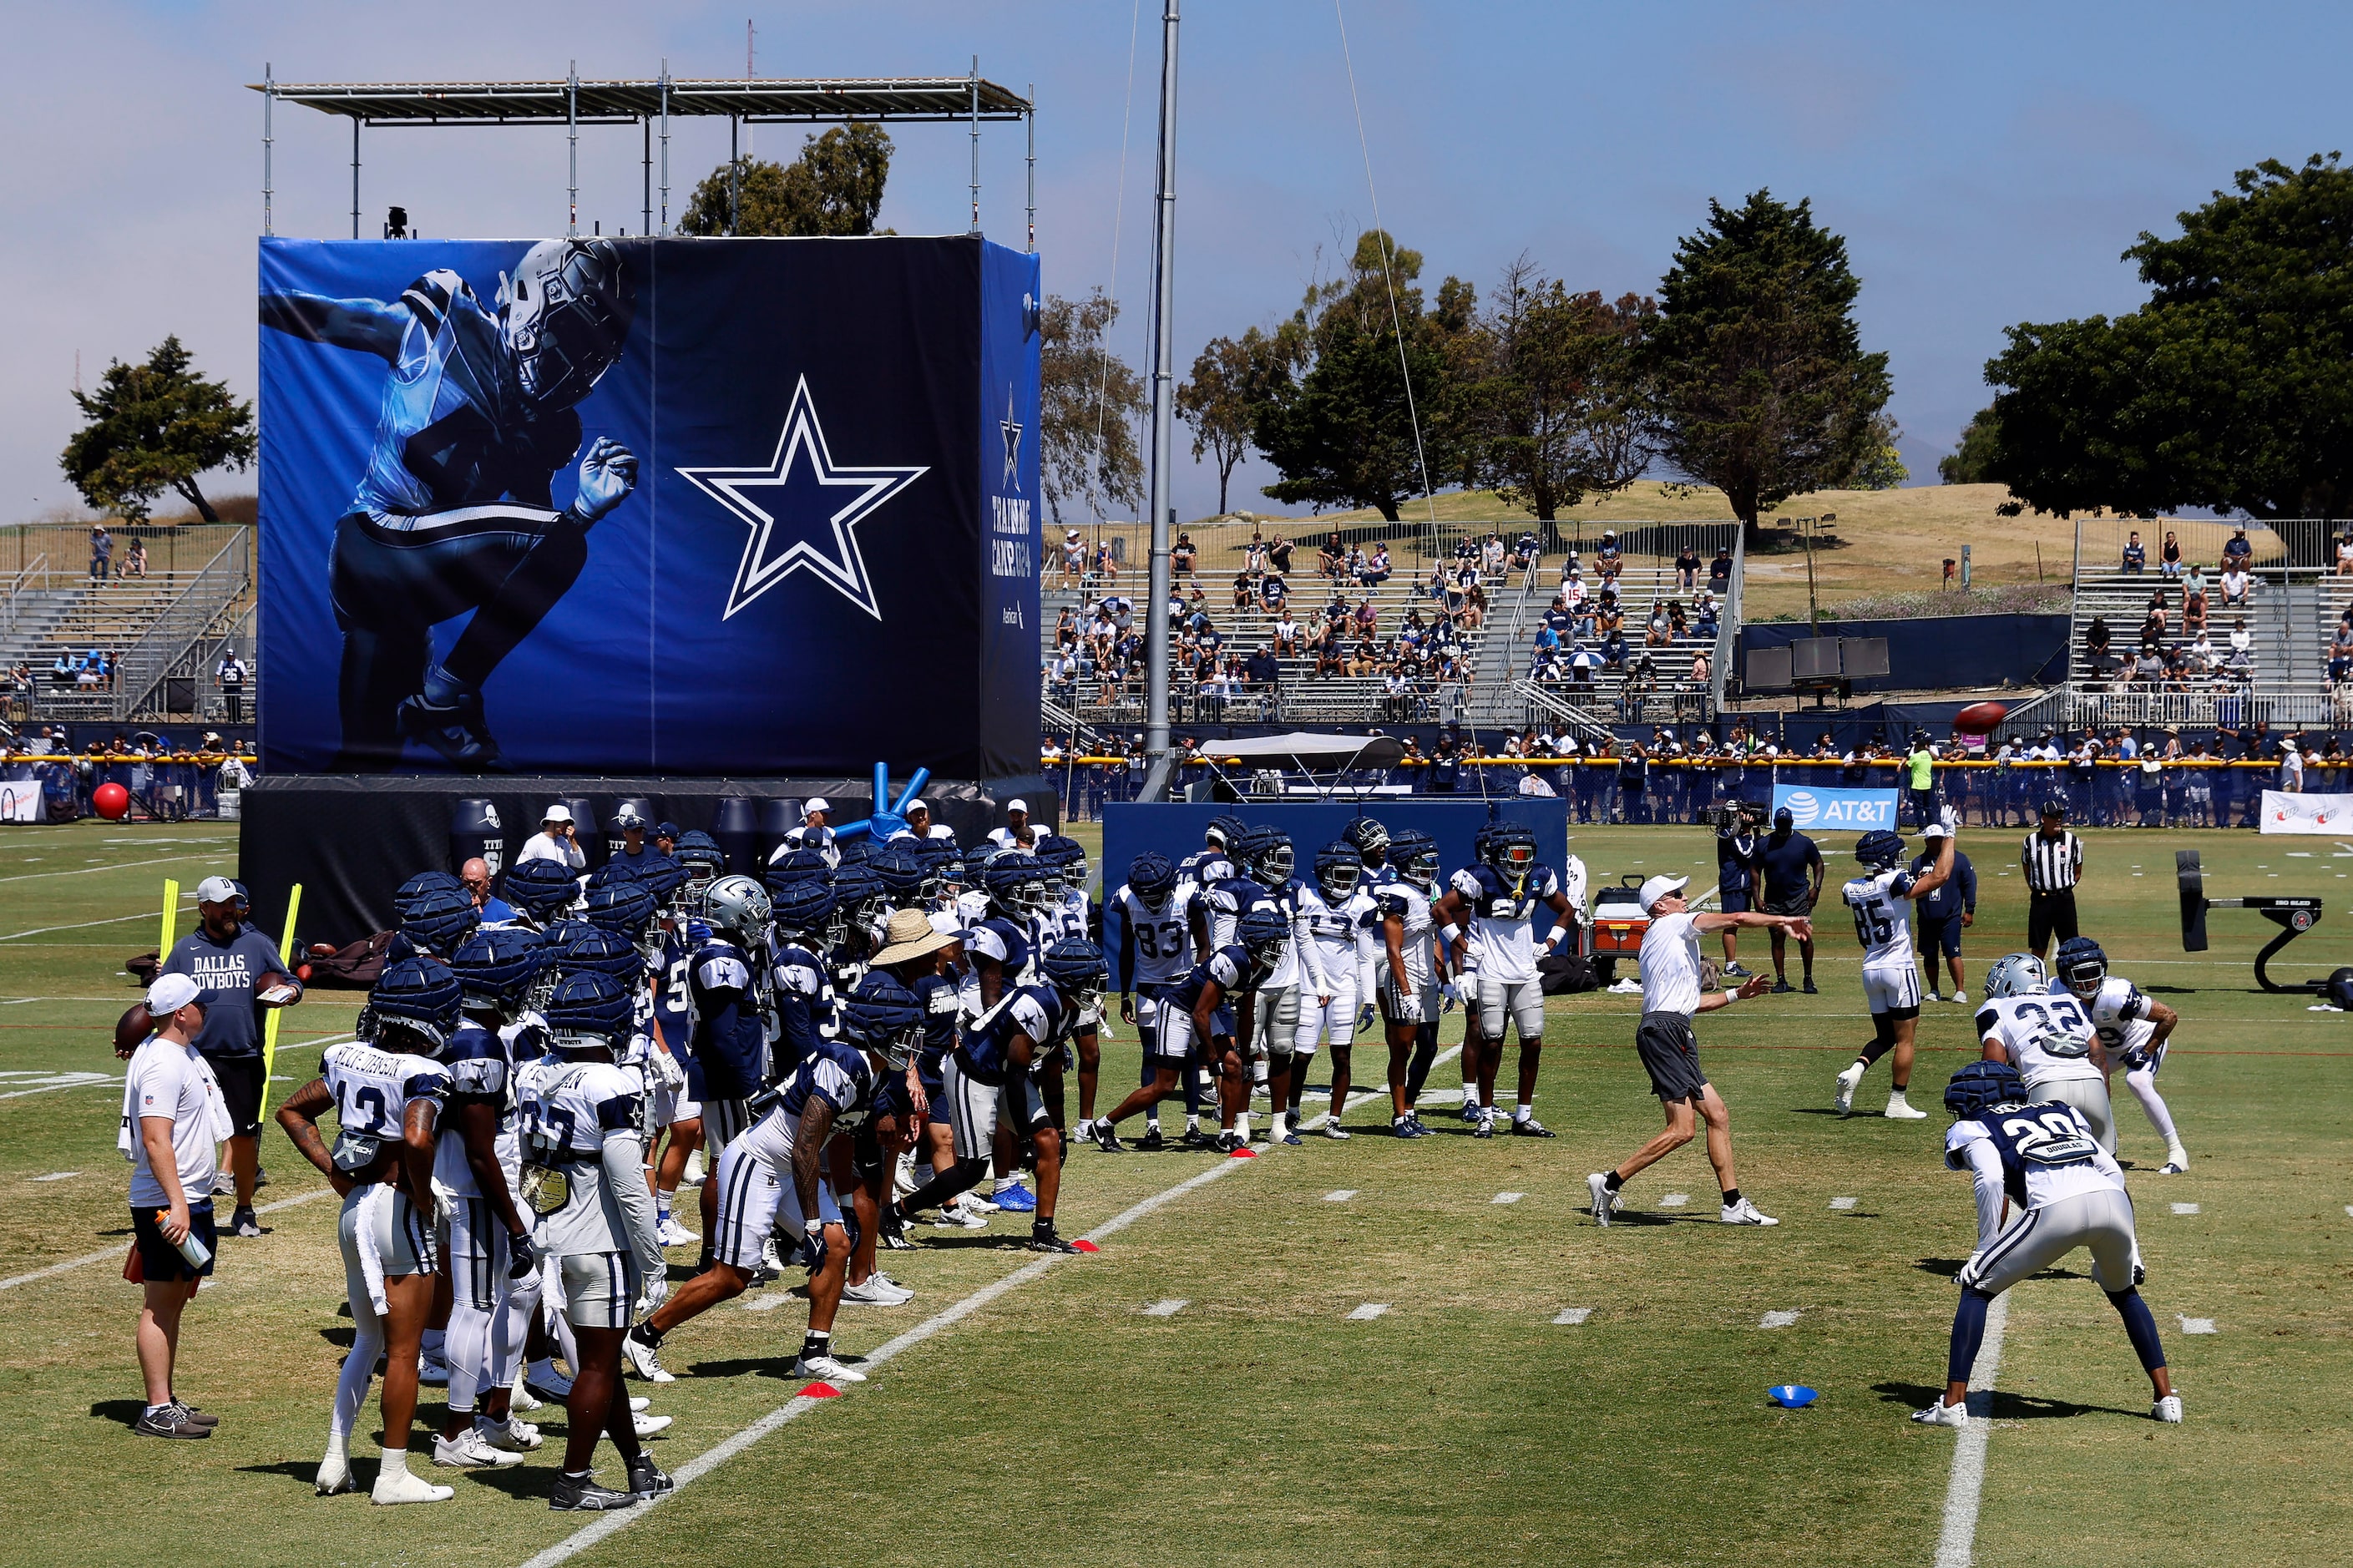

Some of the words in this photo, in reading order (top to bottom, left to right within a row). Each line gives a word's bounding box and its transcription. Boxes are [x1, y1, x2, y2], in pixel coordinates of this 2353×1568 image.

[992, 495, 1030, 535] TRAINNG
[1012, 541, 1031, 578] 024
[1268, 584, 1280, 594] 55
[1568, 589, 1581, 600] 15
[1419, 648, 1429, 661] 9
[224, 667, 238, 682] 26
[1824, 800, 1891, 822] AT&T
[220, 878, 231, 889] D
[1851, 898, 1893, 950] 85
[1134, 920, 1184, 959] 83
[194, 954, 245, 974] DALLAS
[190, 971, 250, 999] COWBOYS
[2014, 1001, 2083, 1044] 32
[337, 1080, 387, 1138] 13
[2046, 1141, 2083, 1153] DOUGLAS
